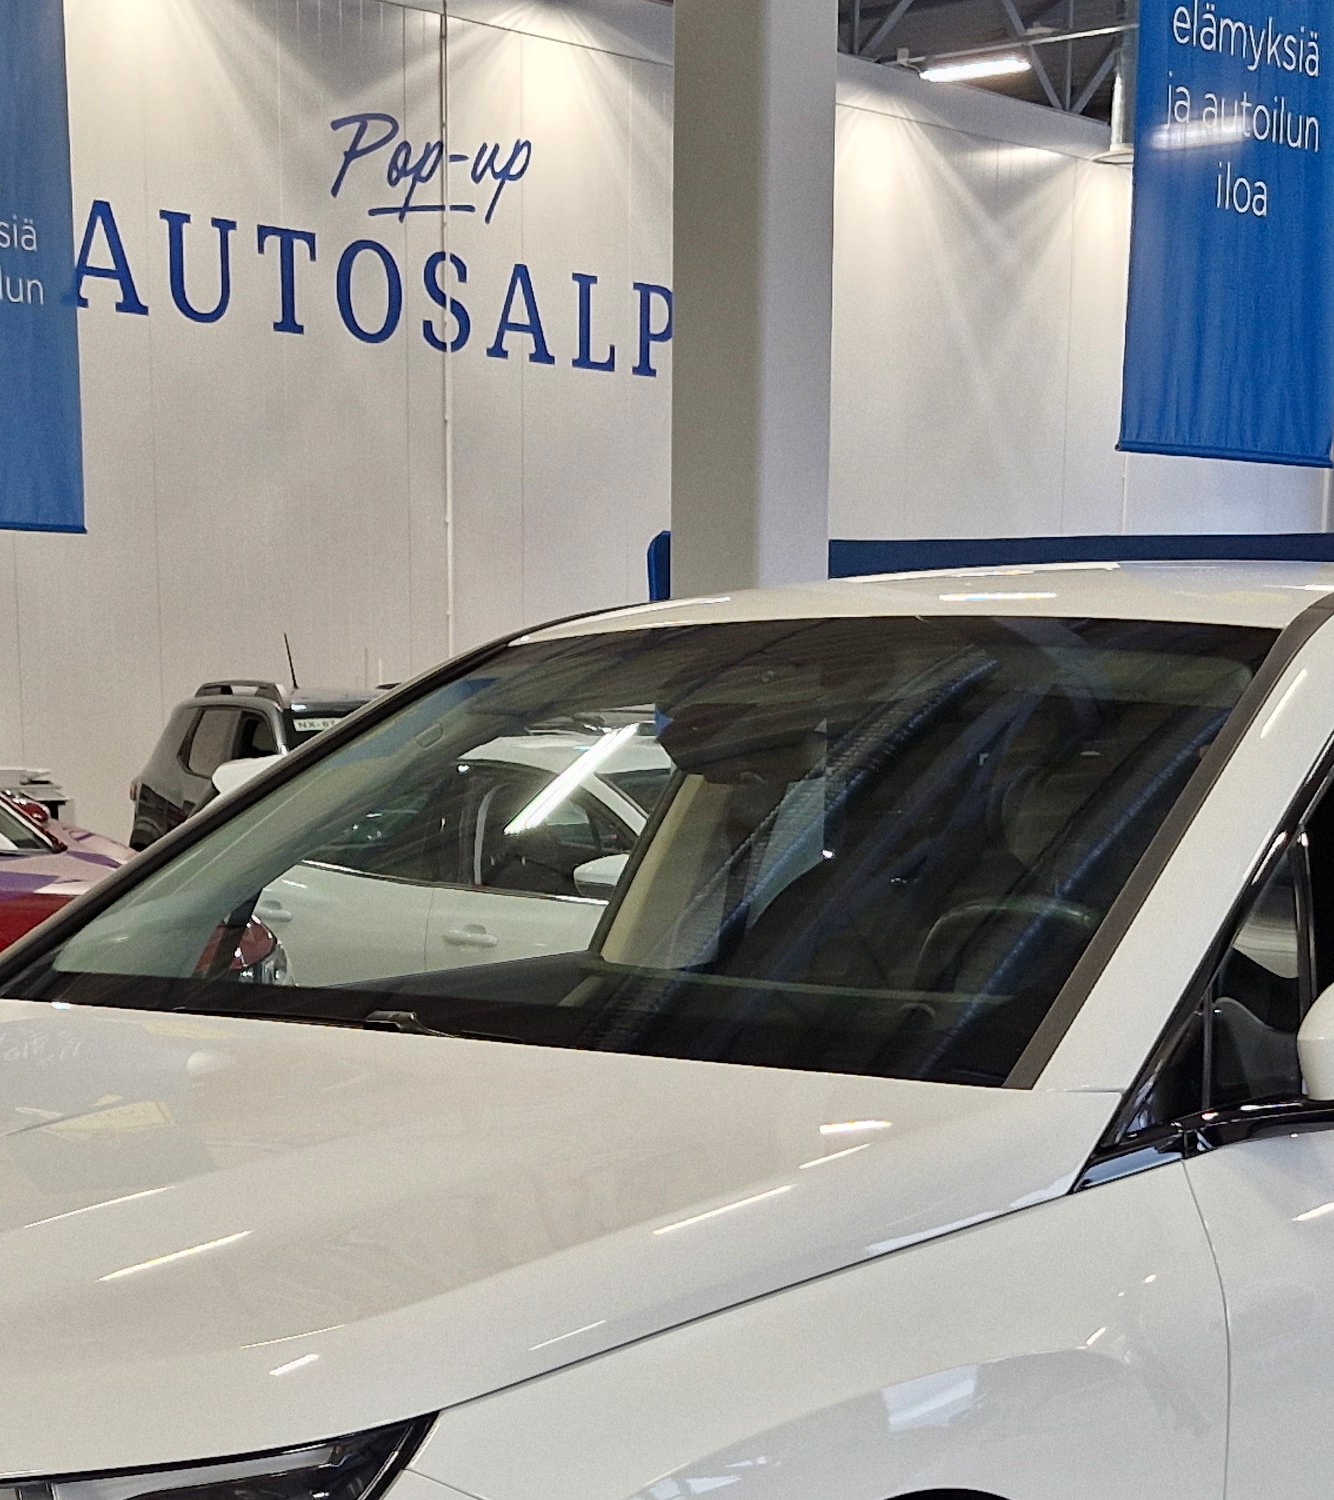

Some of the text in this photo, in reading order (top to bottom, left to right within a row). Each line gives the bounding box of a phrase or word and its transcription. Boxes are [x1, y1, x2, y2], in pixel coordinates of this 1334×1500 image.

[1172, 0, 1320, 78] elämyksiä
[1163, 70, 1320, 153] ja autoilun
[330, 112, 533, 225] Pop-up
[1216, 161, 1268, 218] iloa
